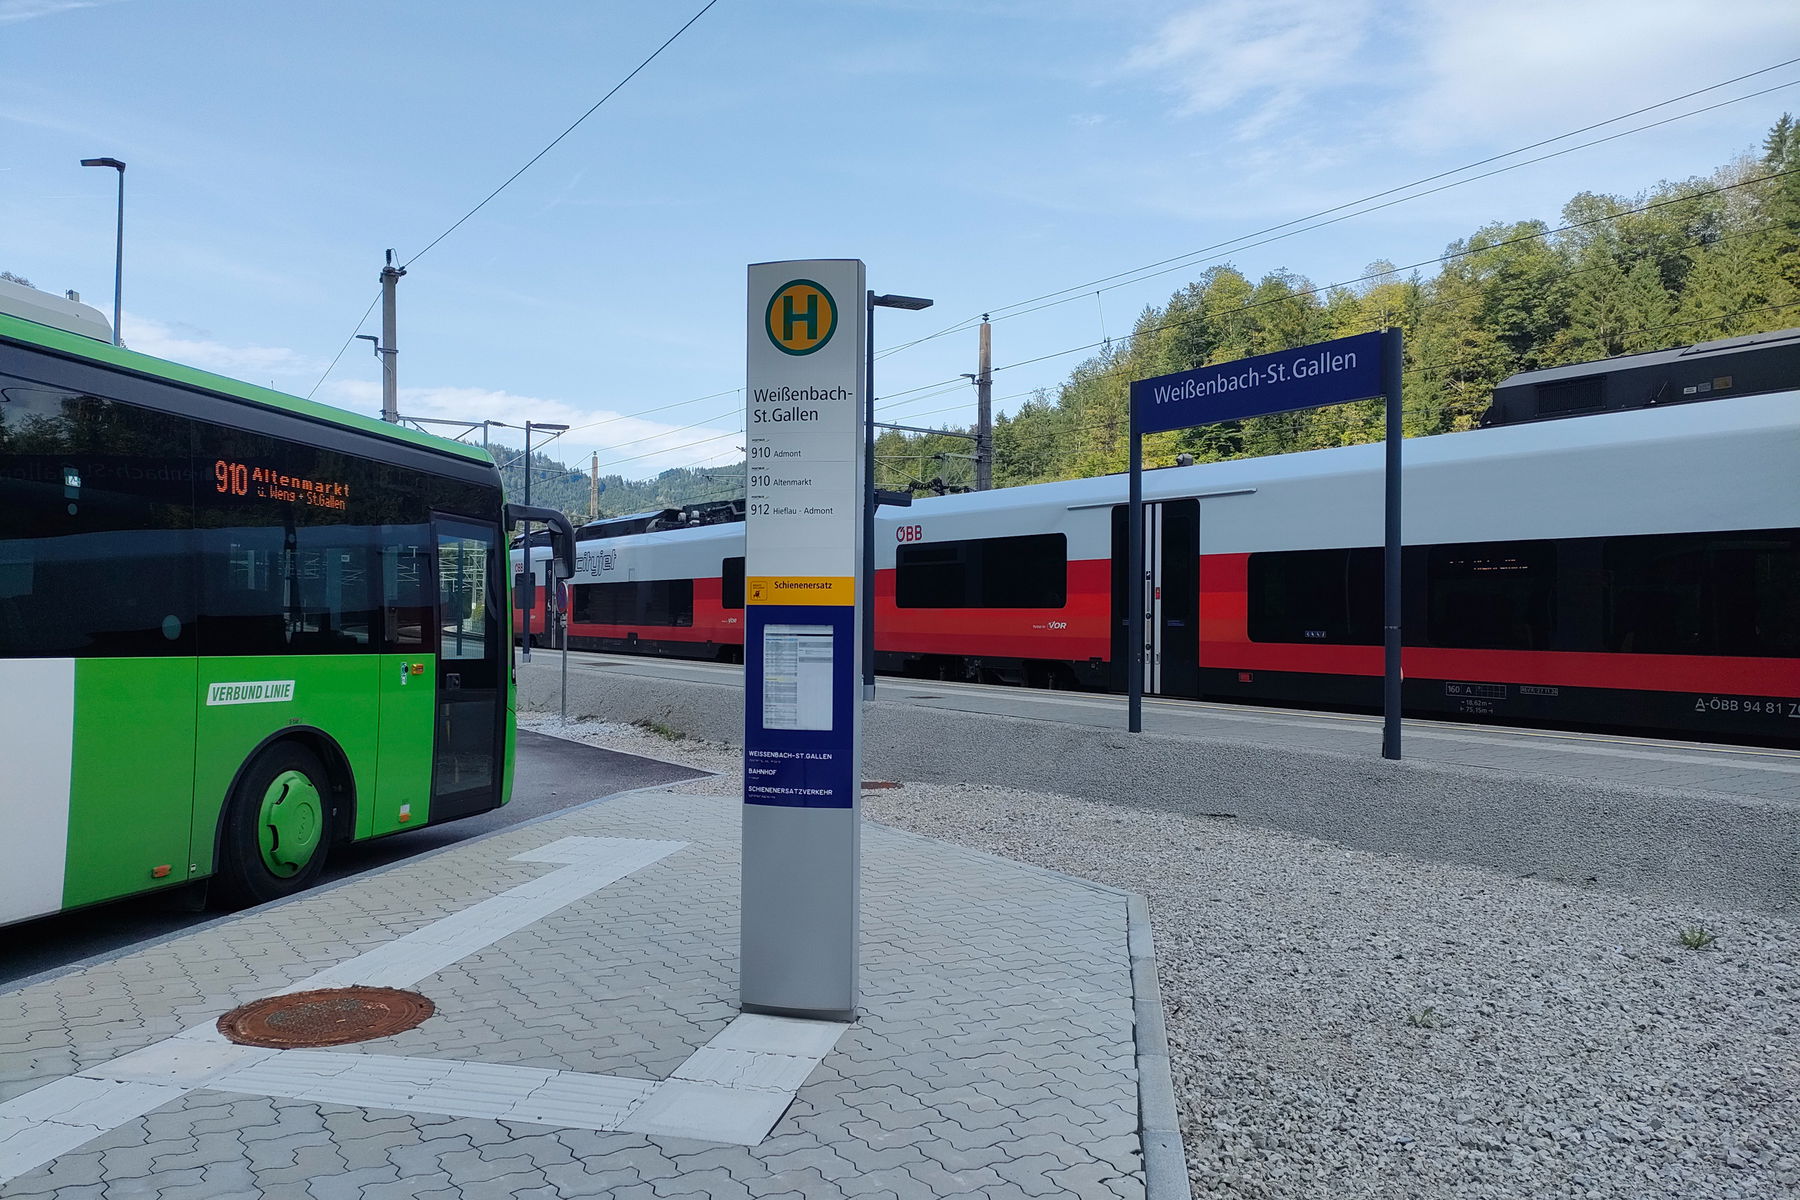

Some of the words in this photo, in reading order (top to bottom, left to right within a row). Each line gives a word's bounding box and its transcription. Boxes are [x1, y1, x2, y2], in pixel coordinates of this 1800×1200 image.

[783, 294, 818, 341] H
[754, 386, 853, 403] Weißenbach-
[751, 447, 771, 458] 910
[773, 450, 802, 458] Admont
[215, 460, 248, 496] 910
[252, 467, 350, 497] Altenmarkt
[751, 475, 771, 487] 910
[773, 478, 812, 486] Altenmarkt
[269, 485, 296, 502] Weng
[751, 503, 770, 515] 912
[804, 507, 833, 515] Admont
[896, 524, 922, 542] ÖBB
[575, 549, 617, 576] cityjet
[774, 581, 833, 590] Schienenersatz
[212, 685, 263, 701] VERBUND
[264, 683, 291, 699] LINIE
[1447, 685, 1460, 694] 160
[1465, 686, 1472, 694] A
[1695, 697, 1739, 712] A-ÖBB
[1743, 701, 1761, 713] 94
[1765, 702, 1782, 714] 81
[748, 768, 777, 776] BAHNHOF
[748, 786, 833, 796] SCHIENENERSATZVERKEHR
